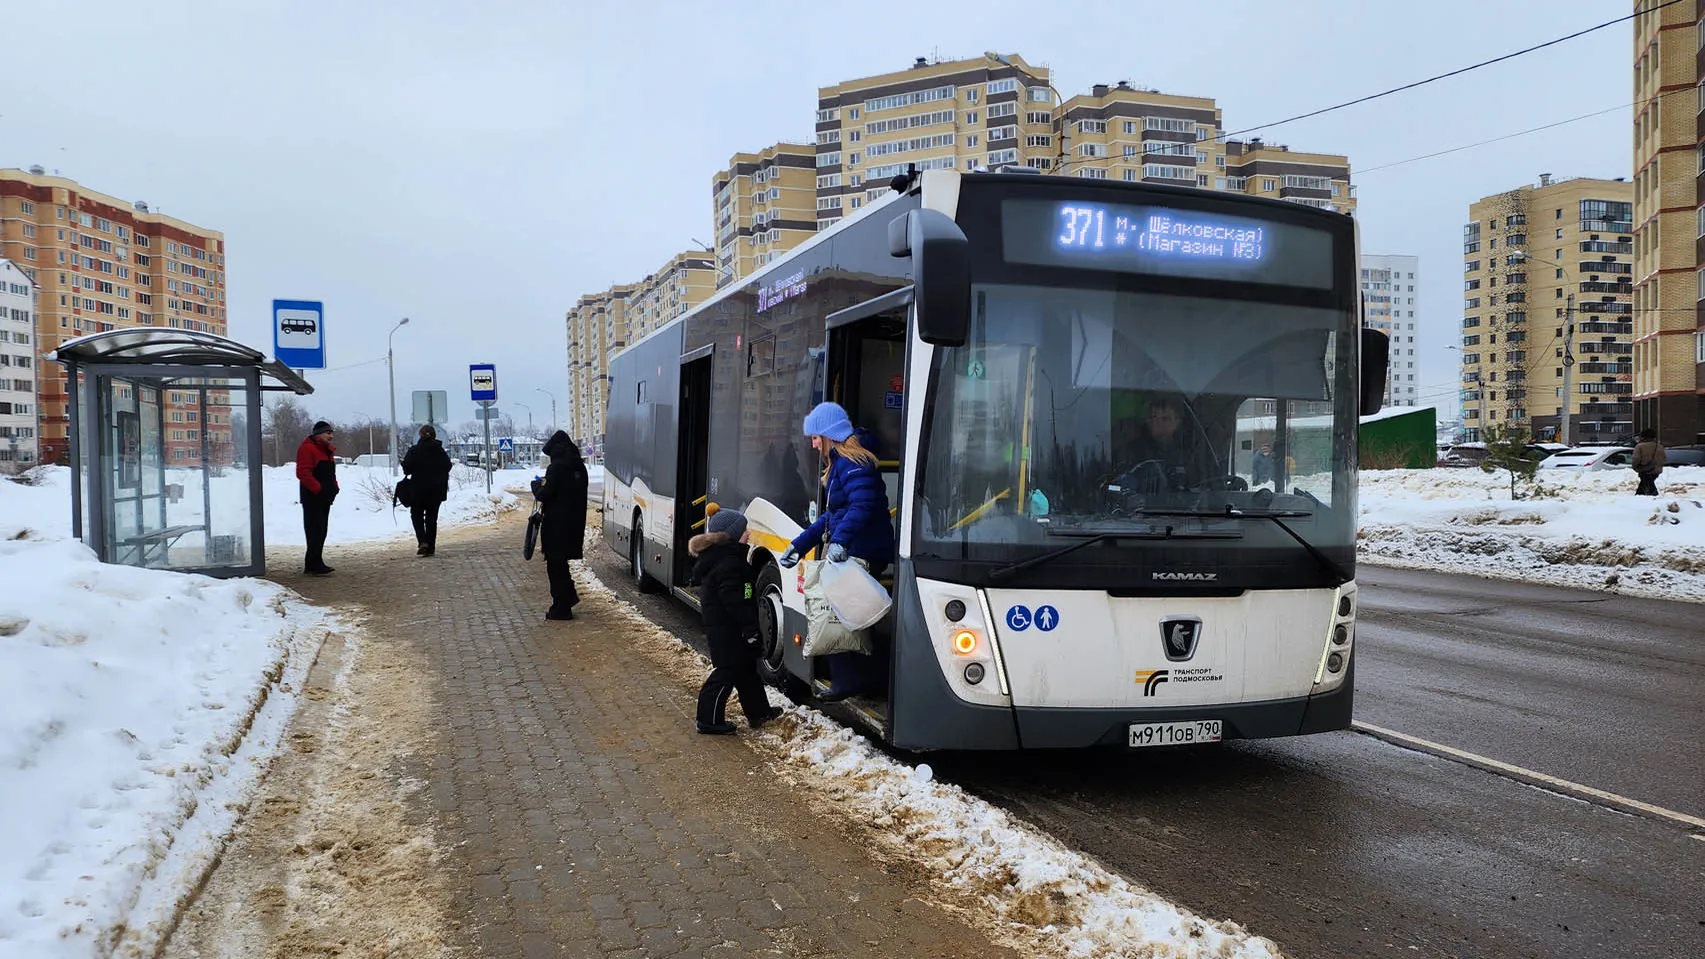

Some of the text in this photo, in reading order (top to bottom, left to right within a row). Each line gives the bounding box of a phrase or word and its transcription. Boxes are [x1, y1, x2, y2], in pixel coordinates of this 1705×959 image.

[1060, 207, 1104, 247] 371
[1152, 572, 1218, 581] KAMAZ
[1173, 675, 1223, 683] ПОДМОСКОВЬЯ
